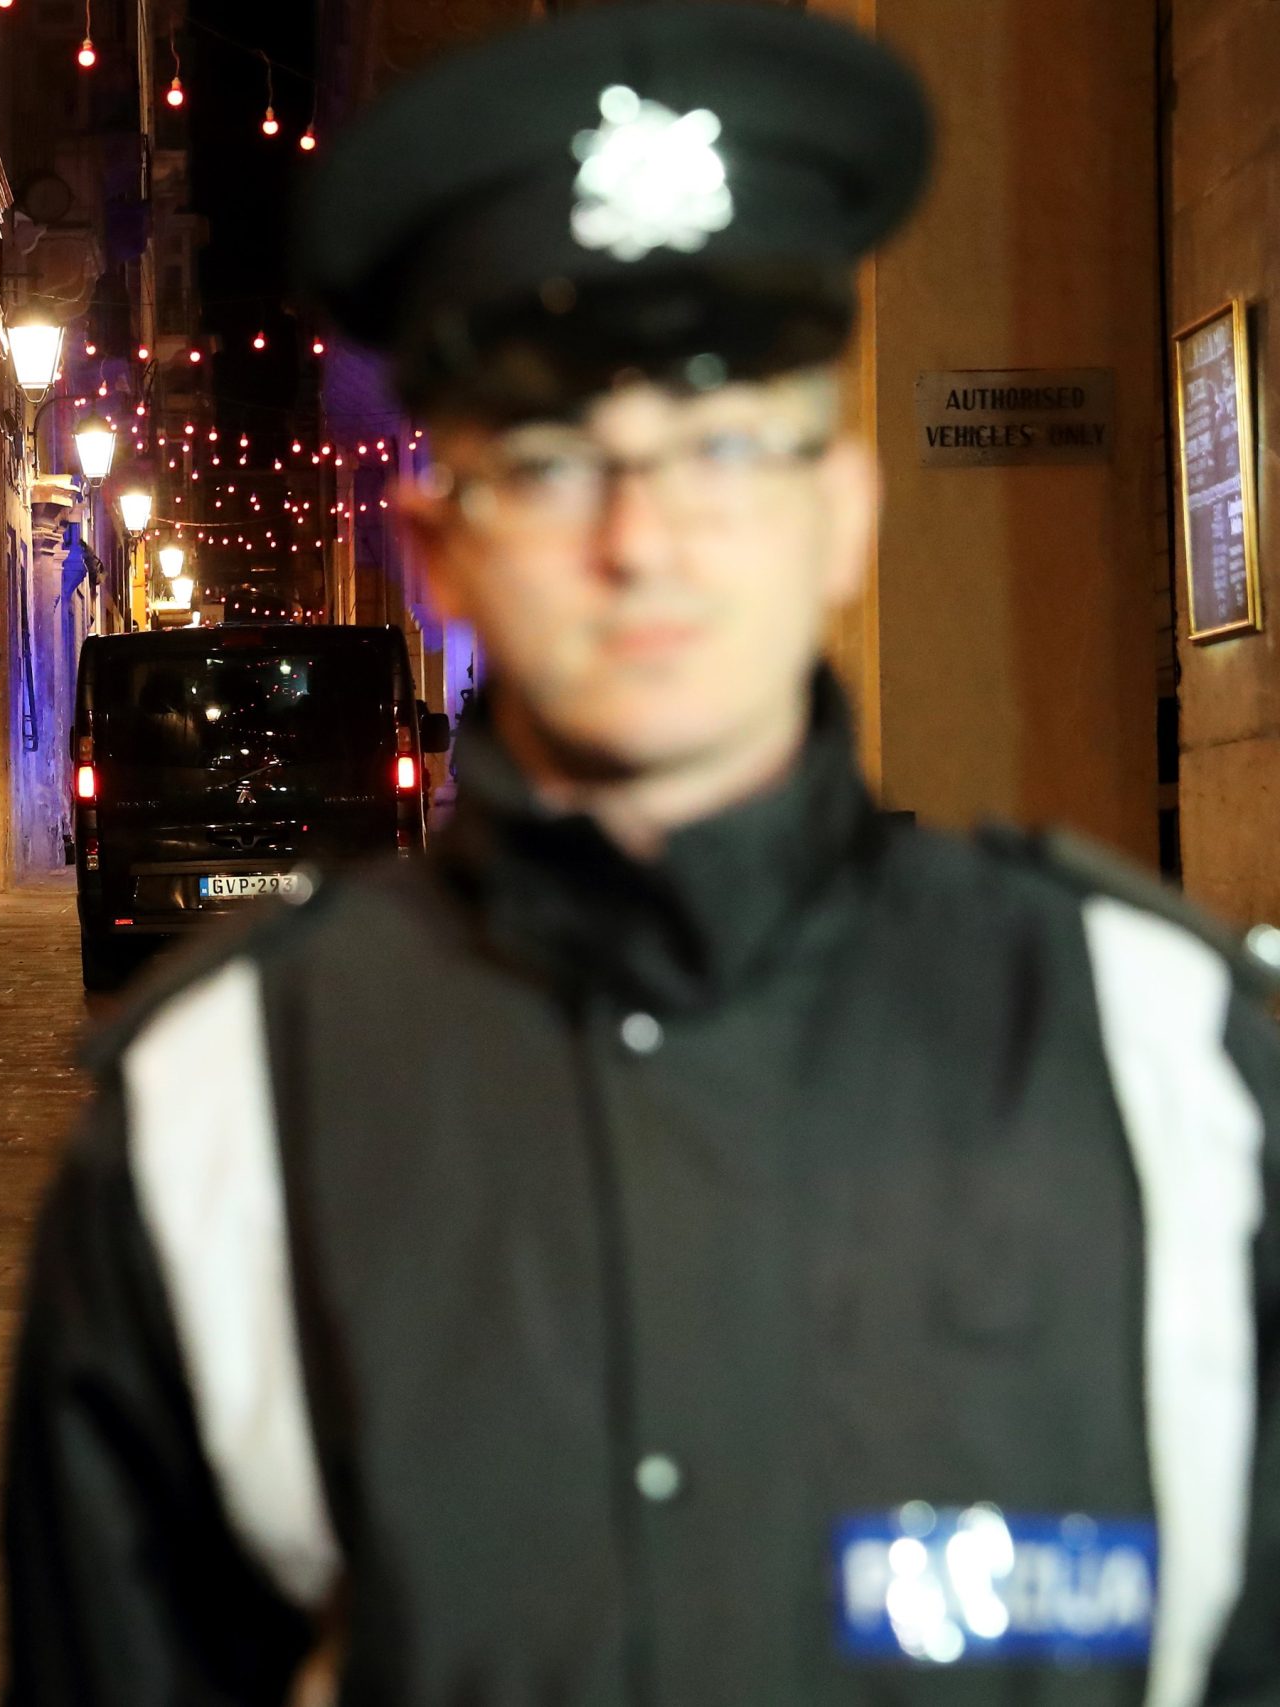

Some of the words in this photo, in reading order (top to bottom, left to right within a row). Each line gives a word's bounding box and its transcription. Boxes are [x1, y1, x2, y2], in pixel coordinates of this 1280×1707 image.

[946, 386, 1085, 411] AUTHORISED
[926, 423, 1036, 449] VEHICLES
[1048, 422, 1106, 447] ONLY
